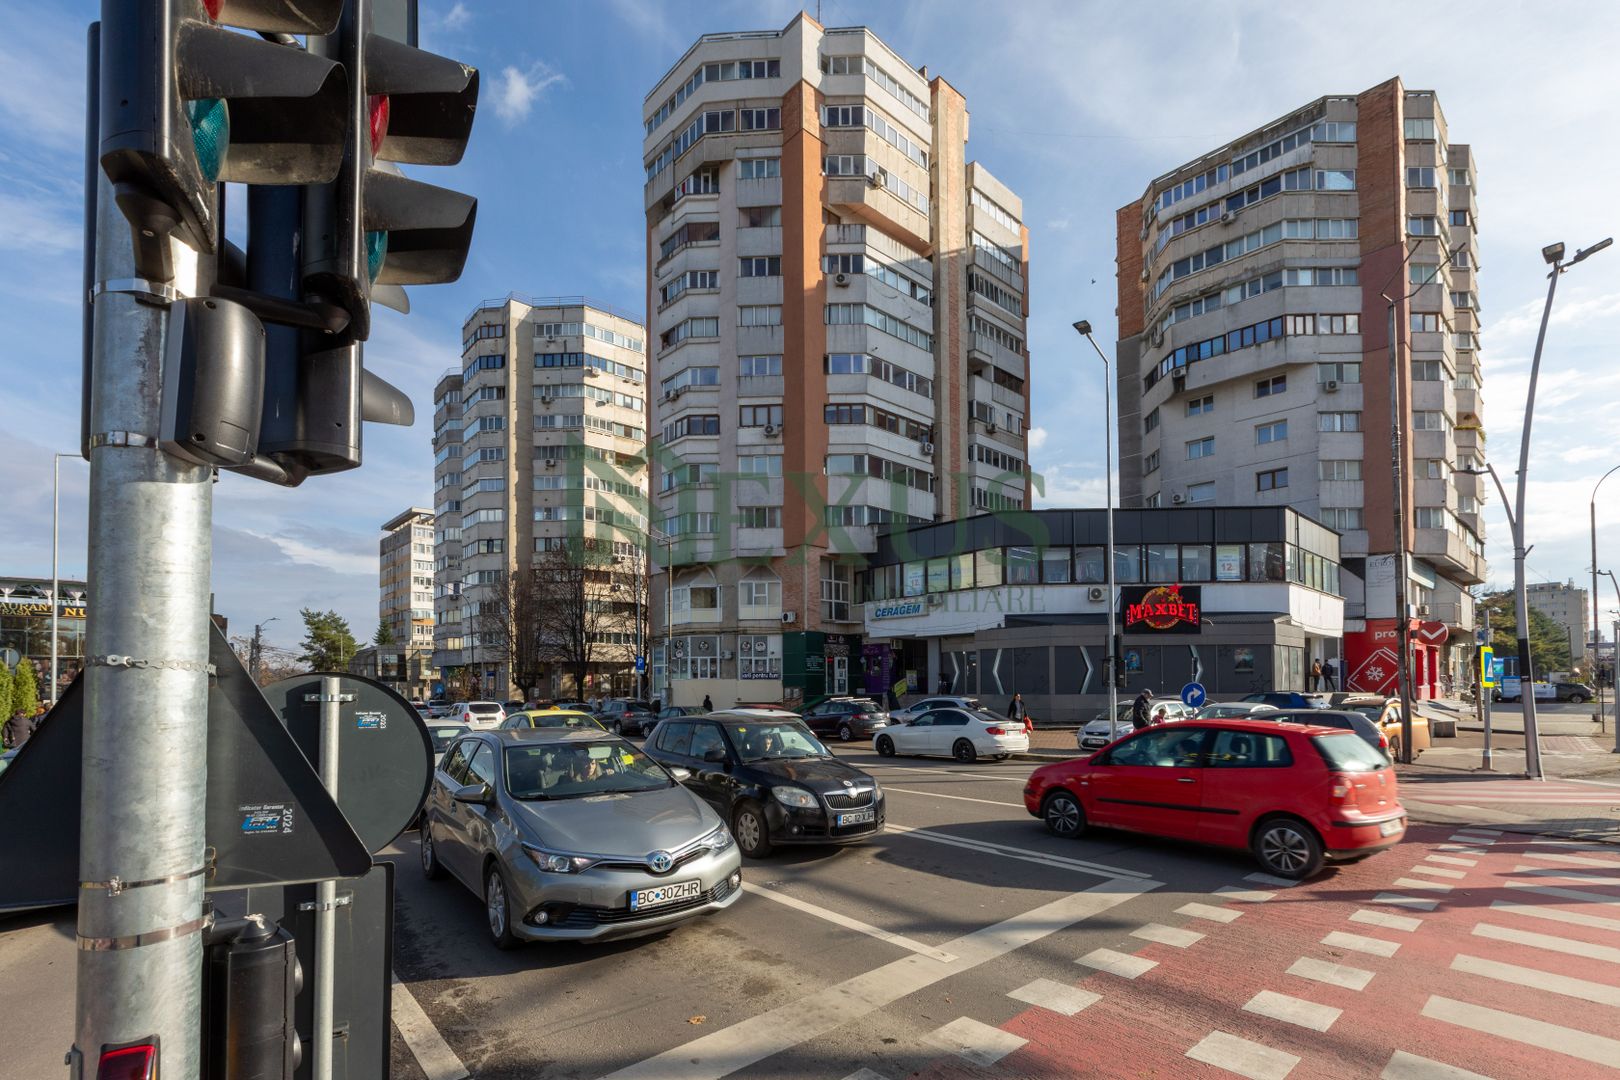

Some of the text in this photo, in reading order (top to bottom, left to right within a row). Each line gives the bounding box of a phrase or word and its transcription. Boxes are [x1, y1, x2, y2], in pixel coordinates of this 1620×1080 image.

[875, 603, 921, 618] CERAGEM
[1129, 602, 1197, 623] MAXBET
[1375, 630, 1397, 640] pro
[283, 808, 293, 833] 2024
